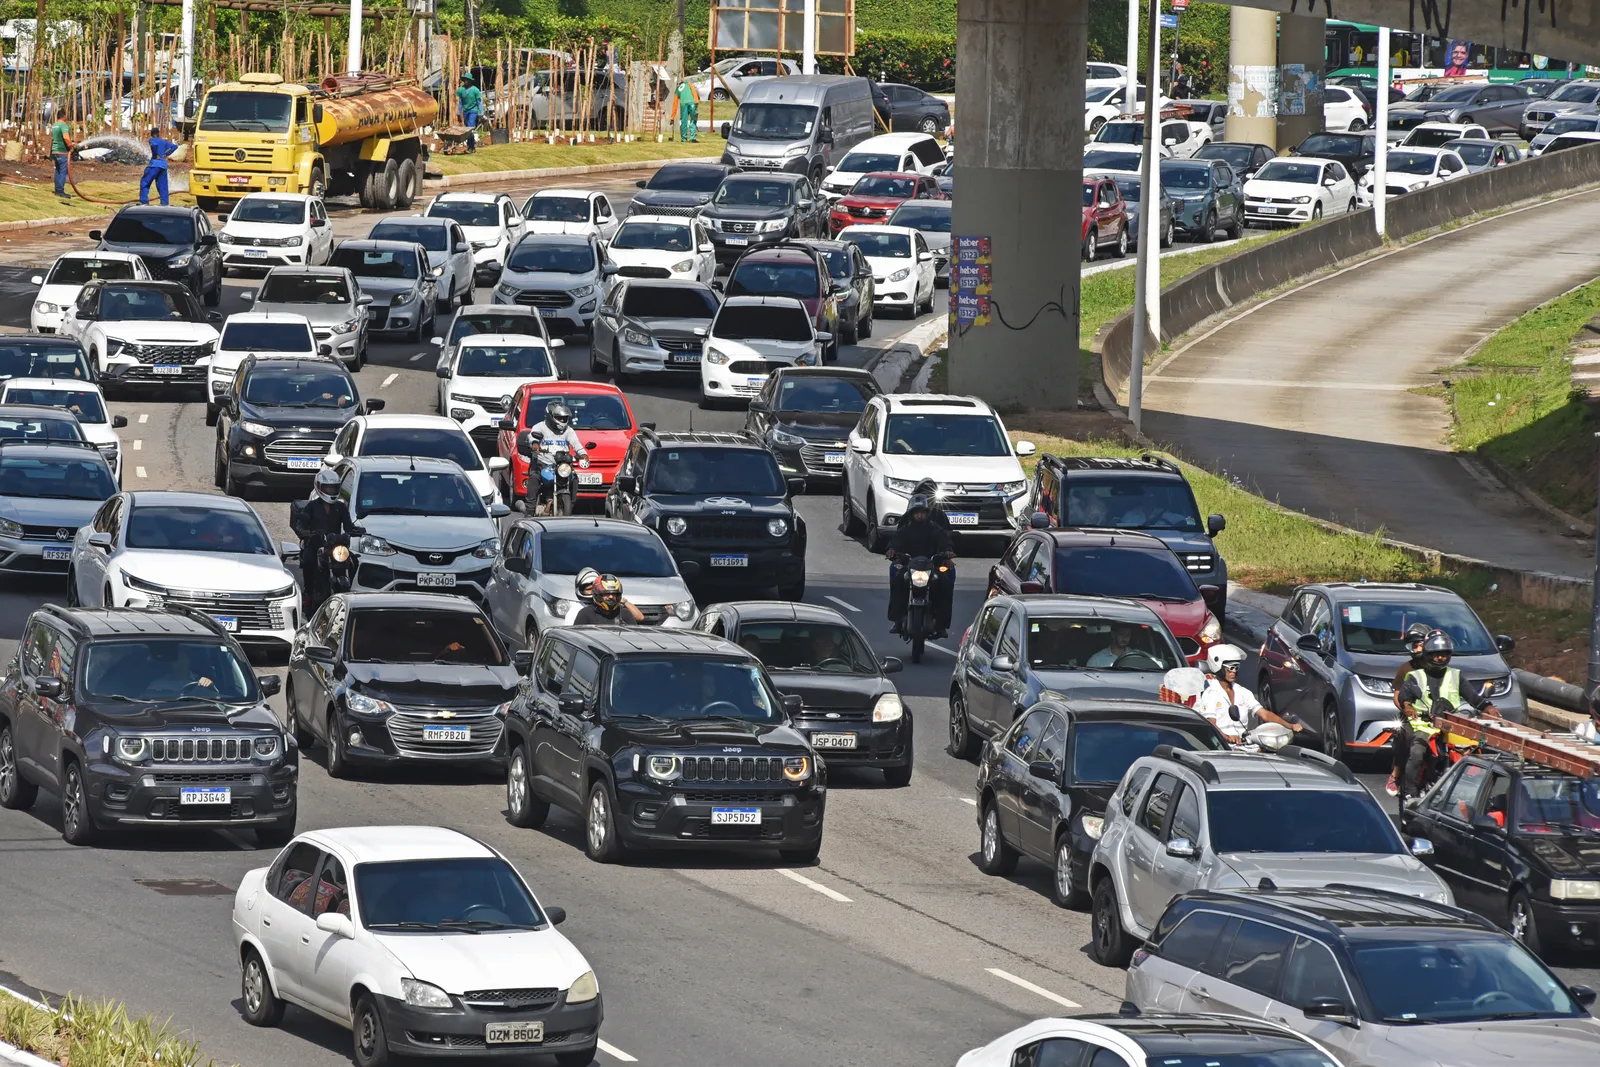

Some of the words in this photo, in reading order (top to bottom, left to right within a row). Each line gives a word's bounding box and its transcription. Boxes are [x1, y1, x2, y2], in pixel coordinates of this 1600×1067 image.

[959, 238, 979, 246] heber
[959, 266, 979, 274] heber
[958, 296, 978, 304] heber
[428, 731, 466, 740] RMF9B20
[186, 793, 226, 802] RPJ3G48
[717, 813, 756, 822] SJP5D52
